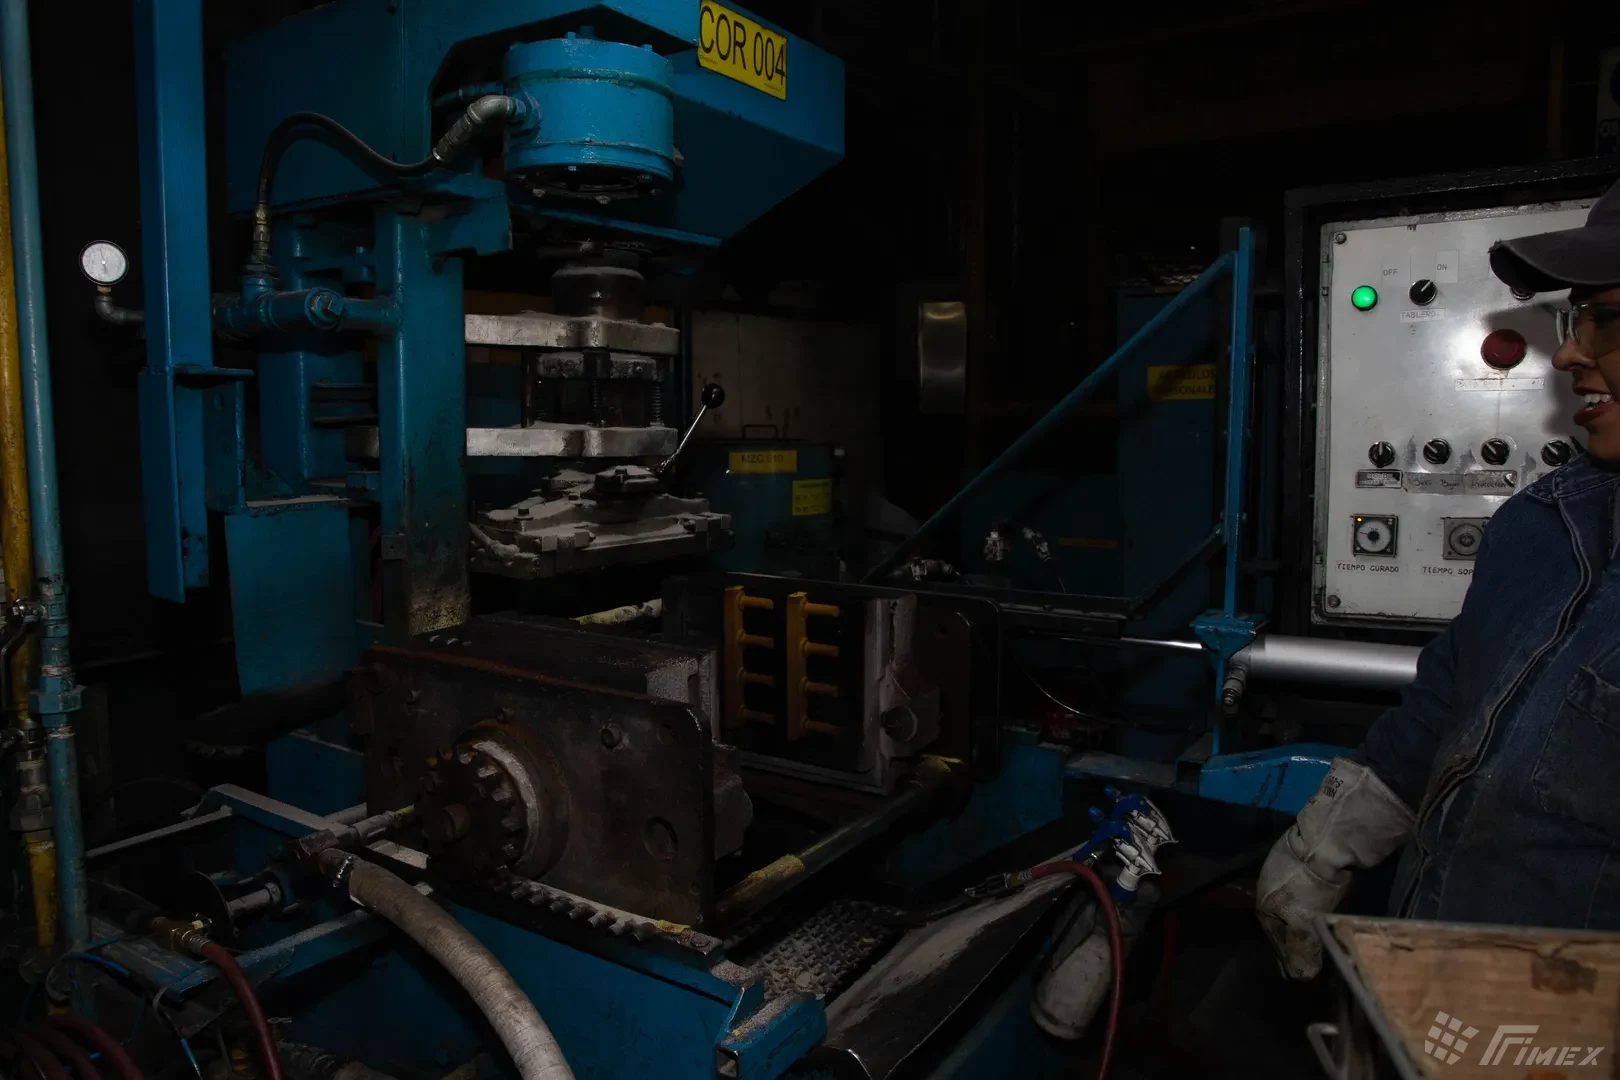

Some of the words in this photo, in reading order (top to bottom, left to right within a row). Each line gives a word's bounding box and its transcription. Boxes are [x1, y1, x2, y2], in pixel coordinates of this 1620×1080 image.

[700, 5, 747, 70] COR
[753, 31, 786, 86] 004
[1383, 268, 1398, 277] OFF
[1436, 263, 1448, 271] ON
[1336, 562, 1366, 572] TIEMPO
[1422, 565, 1454, 576] TIEMPO
